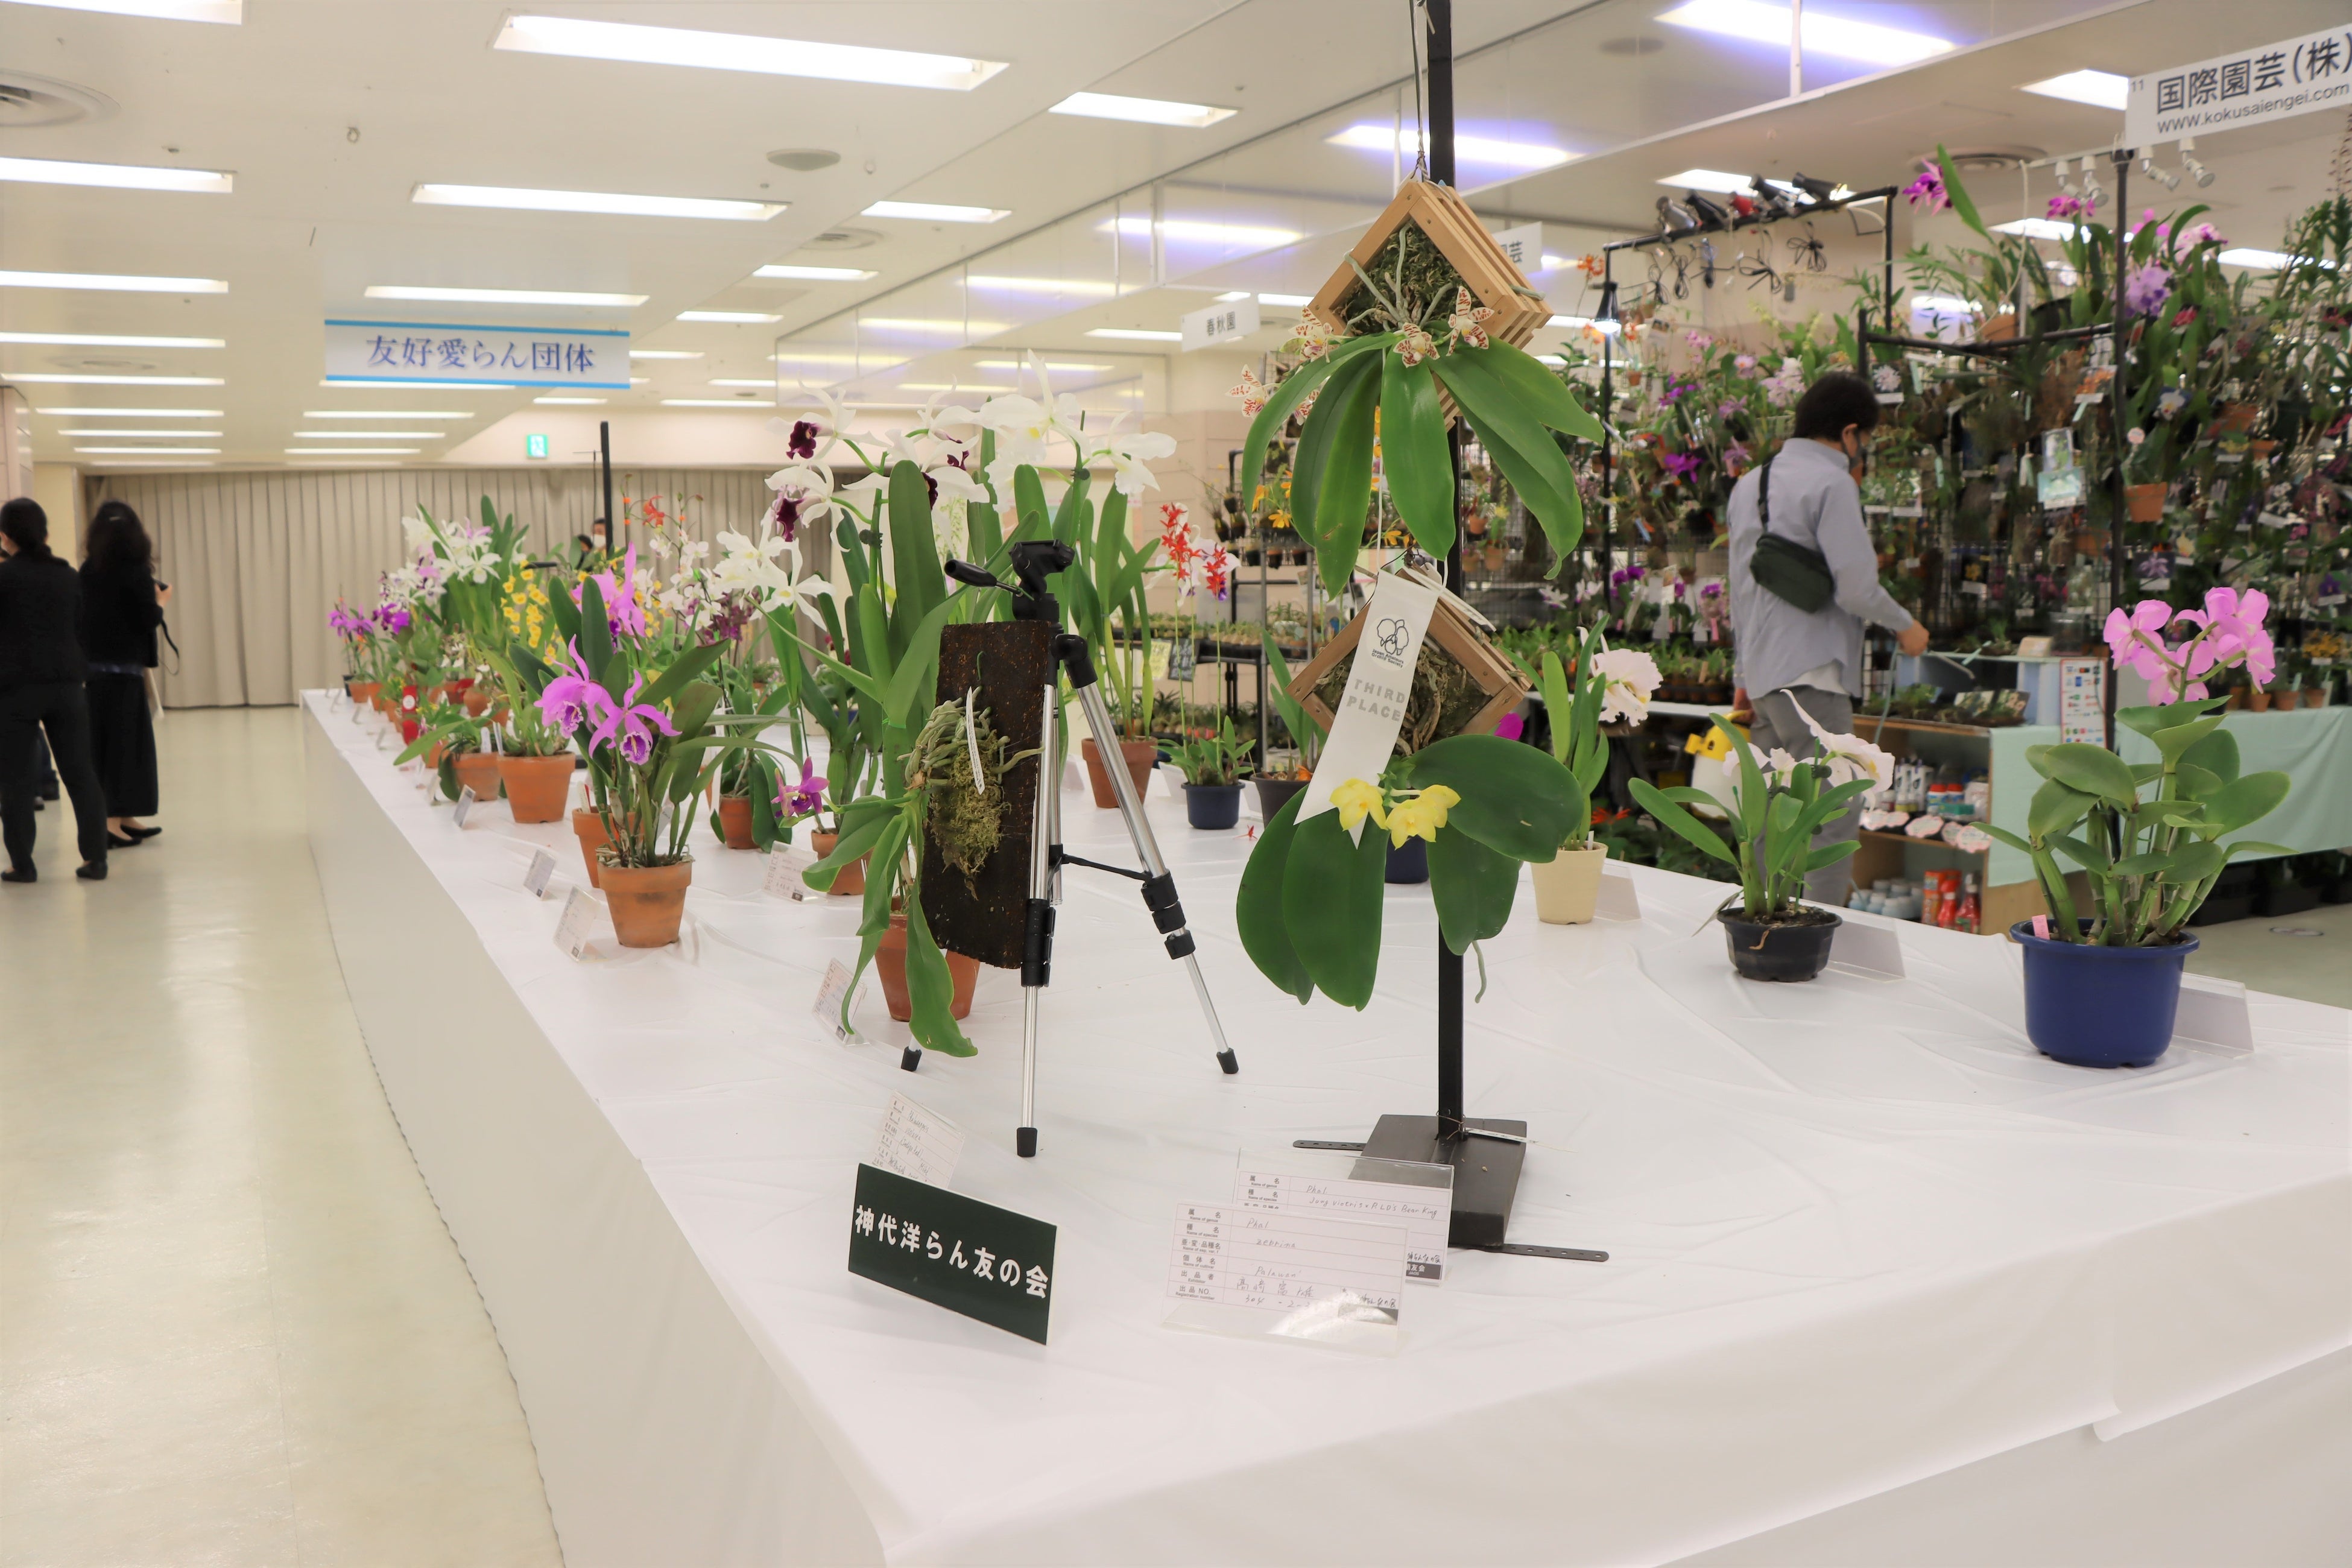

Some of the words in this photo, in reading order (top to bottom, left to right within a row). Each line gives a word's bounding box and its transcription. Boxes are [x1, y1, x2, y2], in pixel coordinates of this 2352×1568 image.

[2131, 80, 2144, 92] 11
[1207, 311, 1236, 337] 春秋園
[367, 335, 595, 373] 友好愛らん団体
[1385, 654, 1404, 664] Amateurs
[1388, 658, 1403, 668] Society
[1355, 678, 1406, 704] THIRD
[1346, 695, 1402, 721] PLACE
[1422, 1206, 1438, 1219] King
[1246, 1217, 1269, 1229] Phal
[855, 1204, 1049, 1298] 神代洋らん友の会
[1183, 1254, 1216, 1265] 個体名
[1181, 1270, 1215, 1280] 出品者
